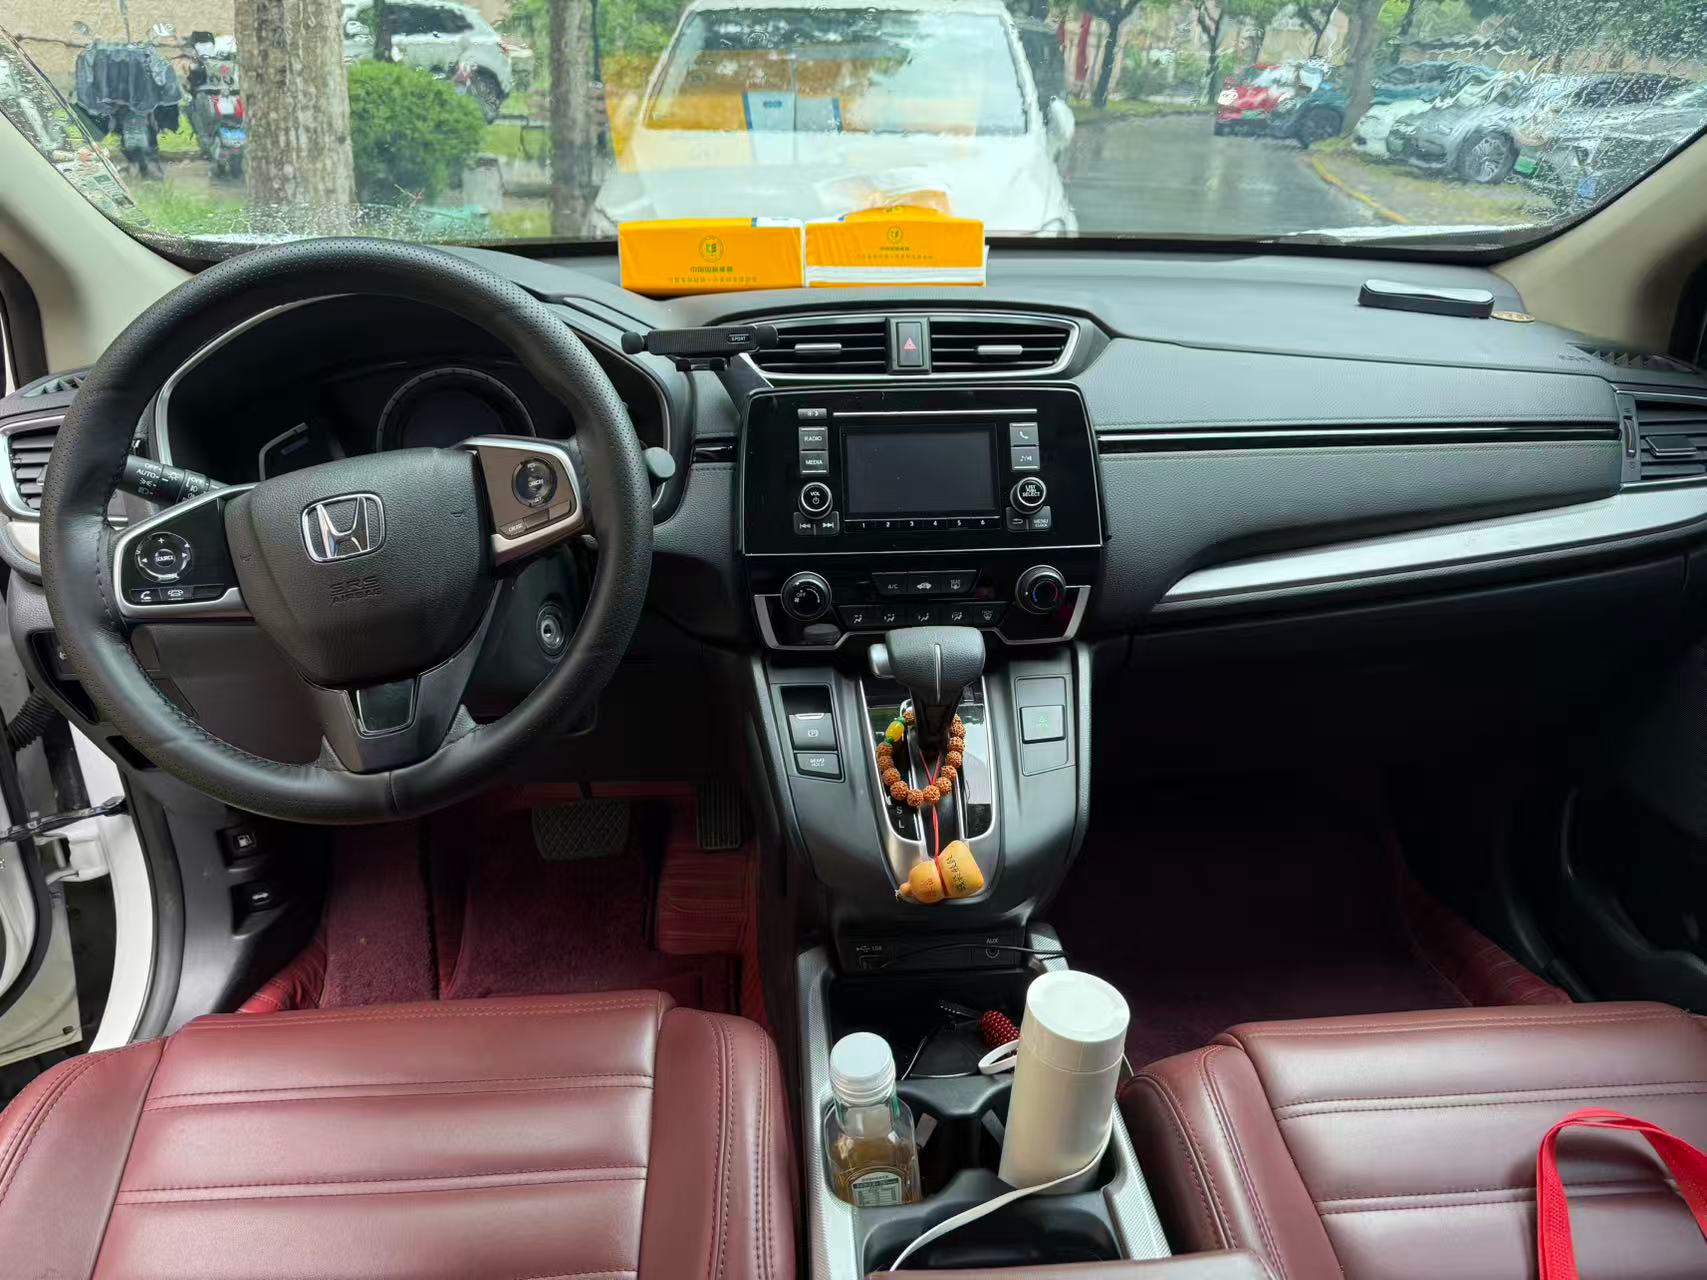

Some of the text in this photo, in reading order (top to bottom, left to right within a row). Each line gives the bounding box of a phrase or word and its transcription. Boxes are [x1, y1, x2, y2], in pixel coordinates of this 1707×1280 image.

[136, 468, 157, 479] AUTO
[896, 806, 903, 815] S
[898, 821, 904, 829] L
